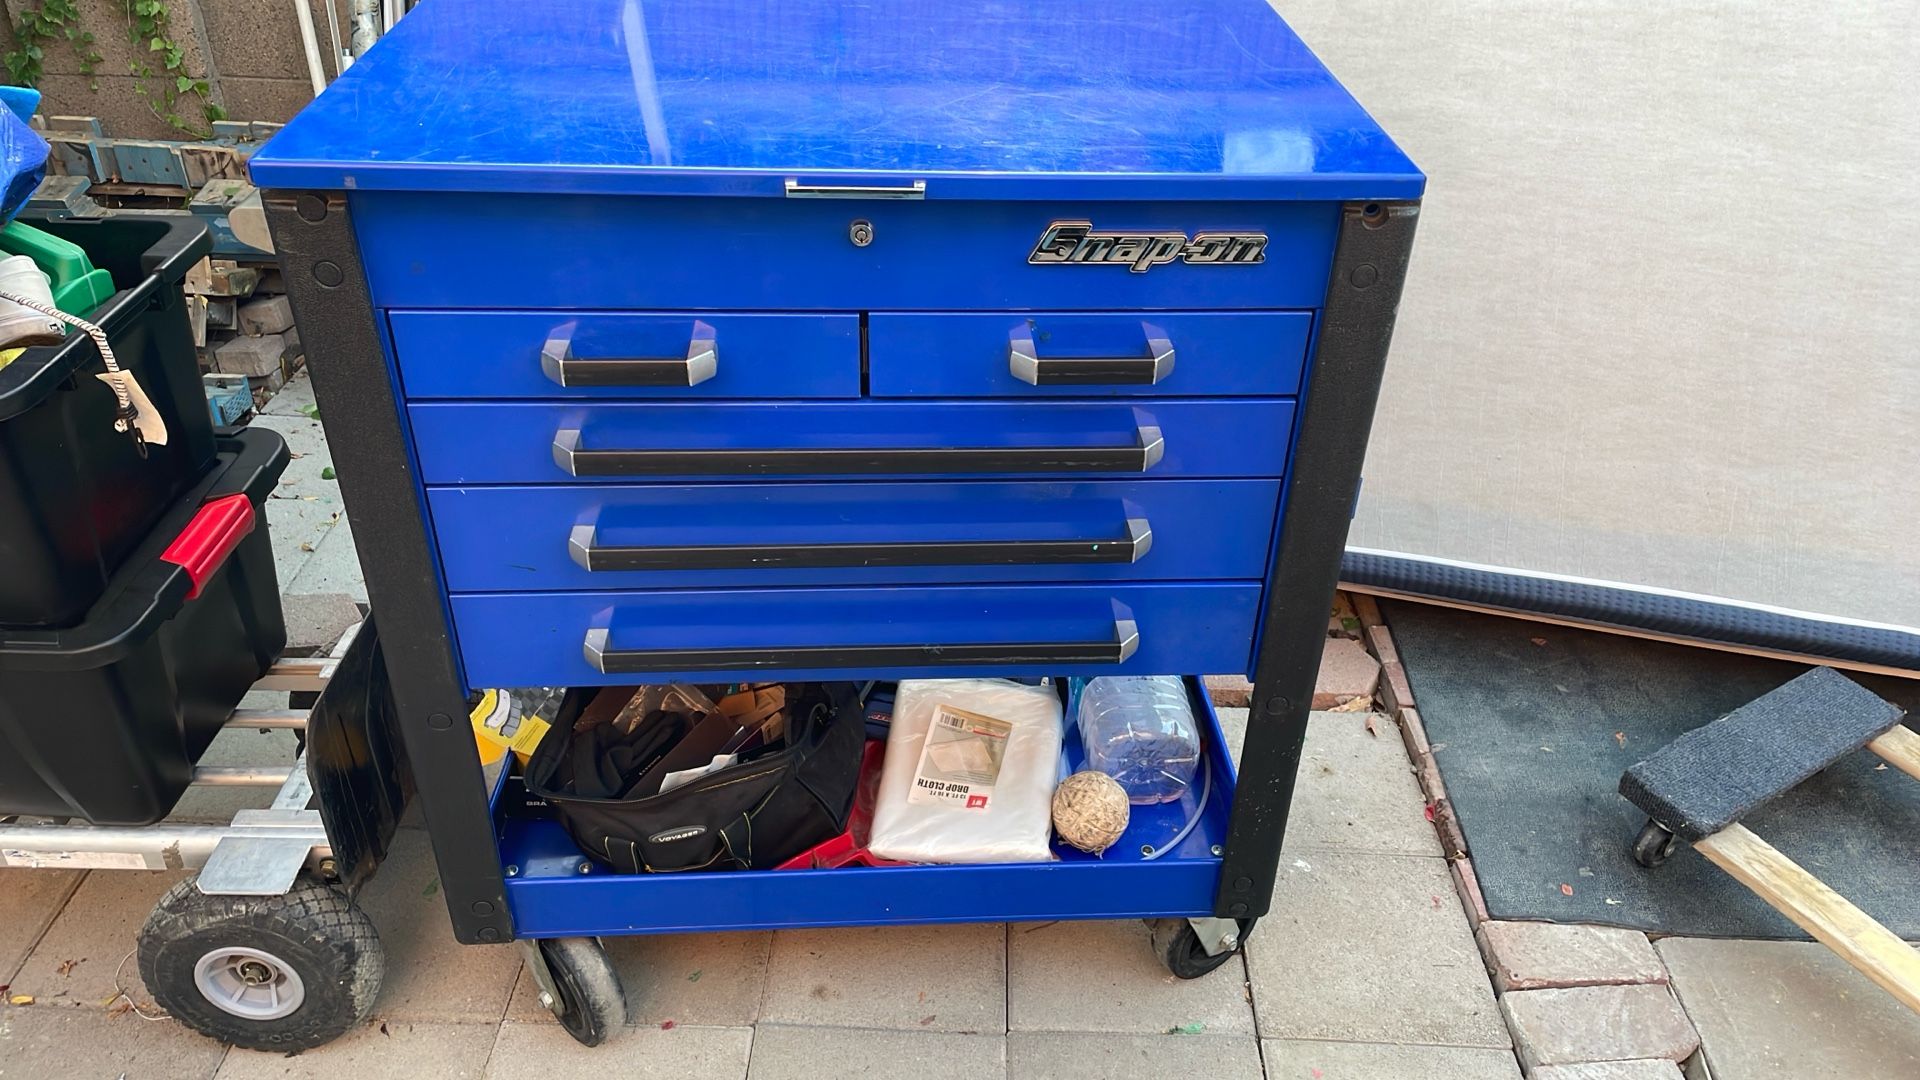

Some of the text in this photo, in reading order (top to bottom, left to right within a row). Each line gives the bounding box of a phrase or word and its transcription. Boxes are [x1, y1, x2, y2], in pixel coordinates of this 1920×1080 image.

[1028, 220, 1268, 273] Snap-on
[917, 778, 969, 794] DROP CLOTH
[658, 830, 698, 843] VOYAGER
